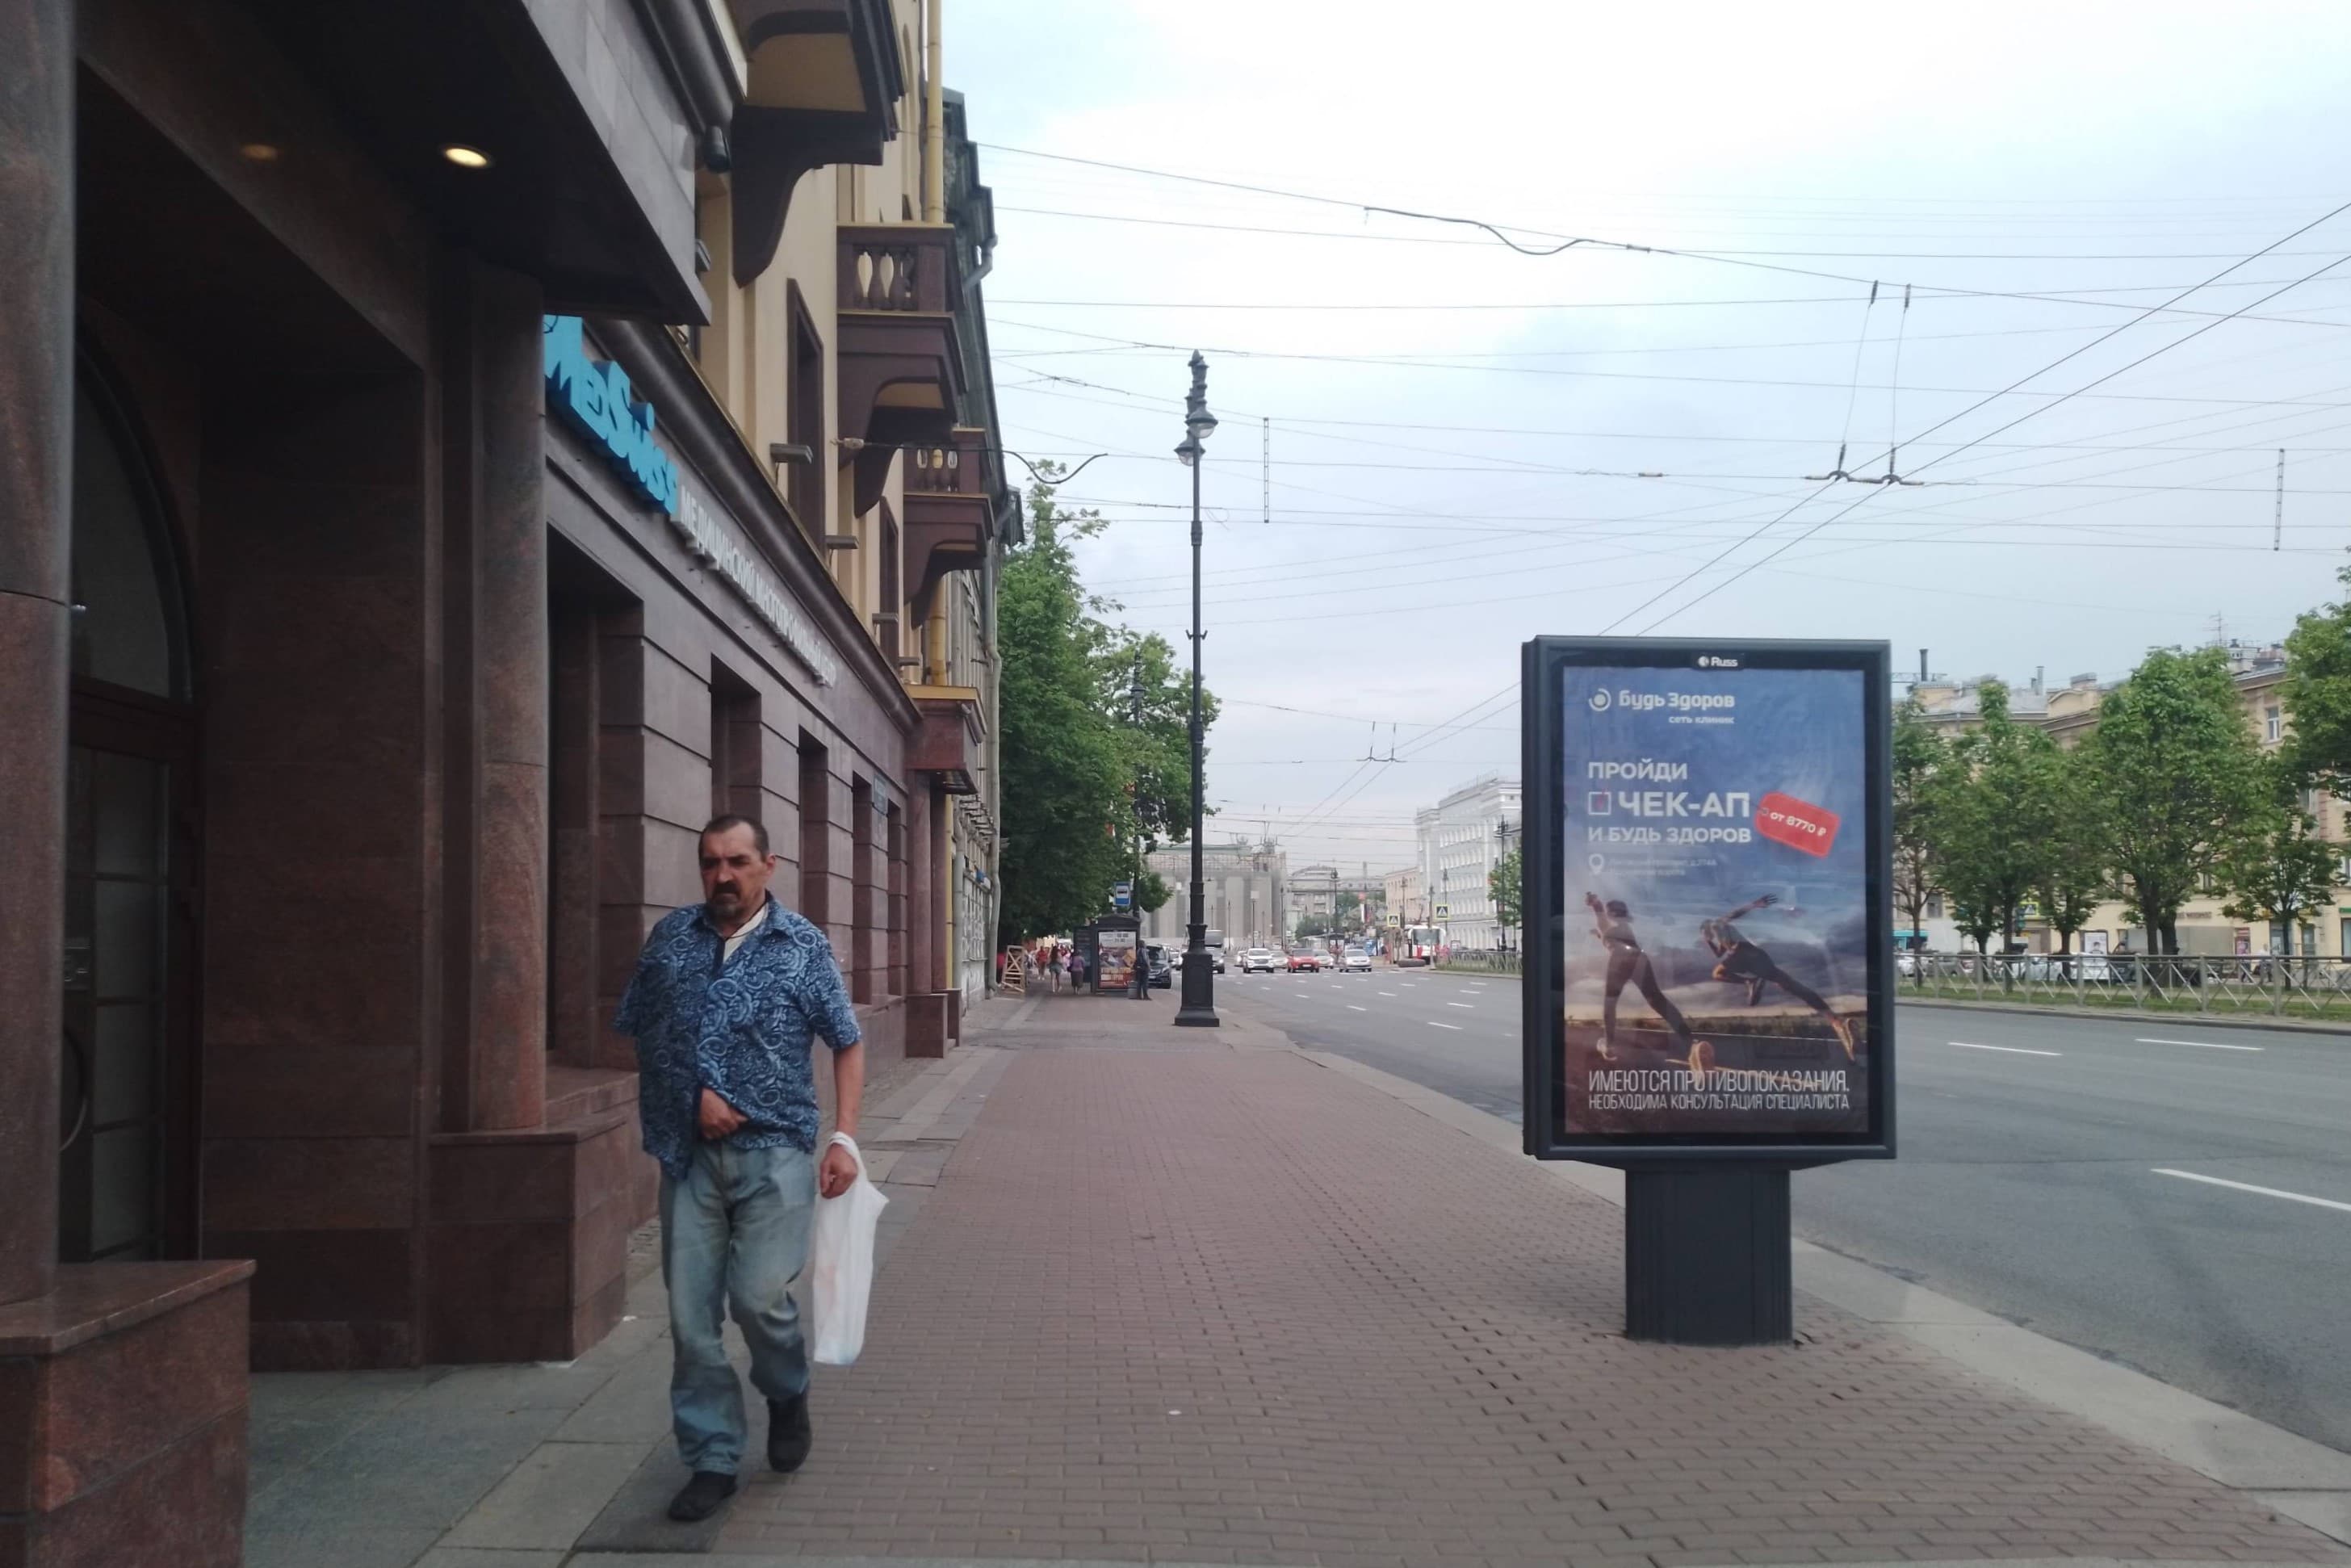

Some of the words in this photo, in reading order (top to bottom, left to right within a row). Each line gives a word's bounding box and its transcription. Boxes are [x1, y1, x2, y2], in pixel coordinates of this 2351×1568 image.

[1710, 656, 1738, 667] Russ
[1667, 692, 1735, 711] Здоров
[1668, 715, 1693, 724] сеть
[1695, 715, 1735, 724] клиник
[1588, 757, 1688, 782] ПРОЙДИ
[1618, 790, 1750, 818] ЧЕК-АП
[1770, 811, 1785, 822] от
[1786, 815, 1817, 834] 8770
[1588, 827, 1603, 841] И
[1608, 827, 1662, 844] БУДЬ
[1666, 828, 1752, 845] ЗДОРОВ
[1589, 1070, 1670, 1092] ИМЕЮТСЯ
[1674, 1070, 1850, 1092] ПРОТИВОПОКАЗАНИЯ.
[1589, 1094, 1667, 1110] НЕОБХОДИМА
[1670, 1094, 1763, 1110] КОНСУЛЬТАЦИЯ
[1765, 1094, 1850, 1111] СПЕЦИАЛИСТА
